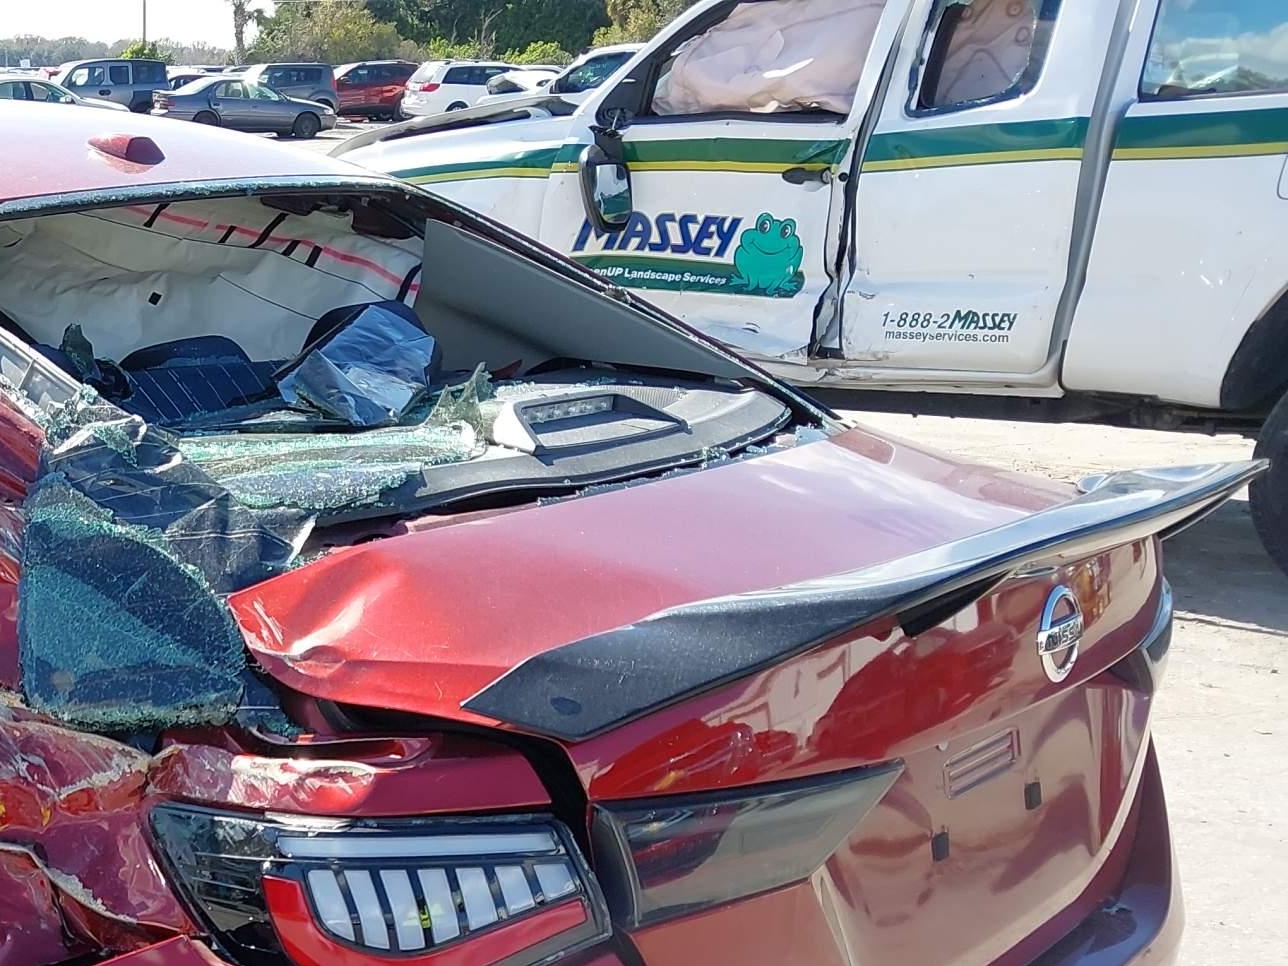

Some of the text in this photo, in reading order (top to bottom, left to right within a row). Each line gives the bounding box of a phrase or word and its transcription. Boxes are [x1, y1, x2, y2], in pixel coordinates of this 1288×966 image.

[624, 267, 682, 282] Landscape
[682, 272, 727, 286] Services
[882, 309, 1018, 331] 1-888-2MASSEY
[885, 329, 1009, 343] masseyservices.com
